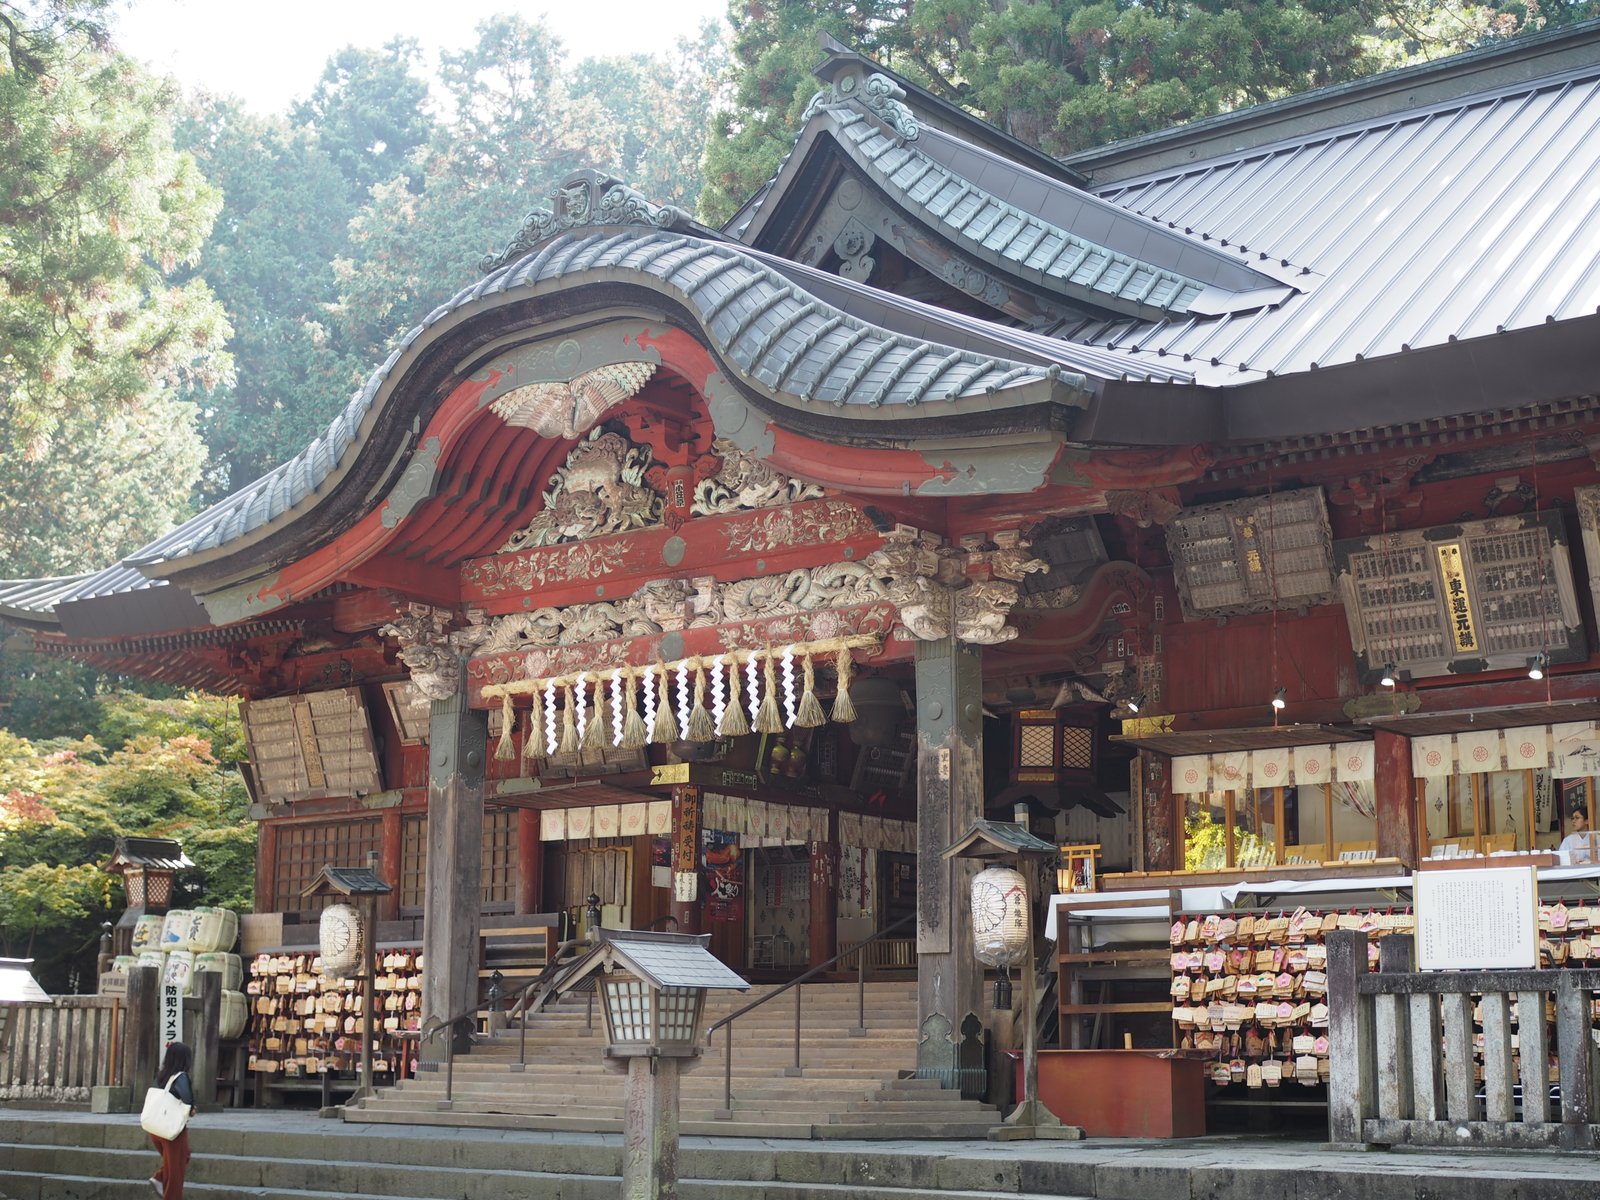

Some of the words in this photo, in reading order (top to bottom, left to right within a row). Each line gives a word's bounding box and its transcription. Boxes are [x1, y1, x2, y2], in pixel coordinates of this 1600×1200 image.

[1449, 578, 1474, 648] 東運元講
[165, 985, 178, 1041] 防犯カメラ
